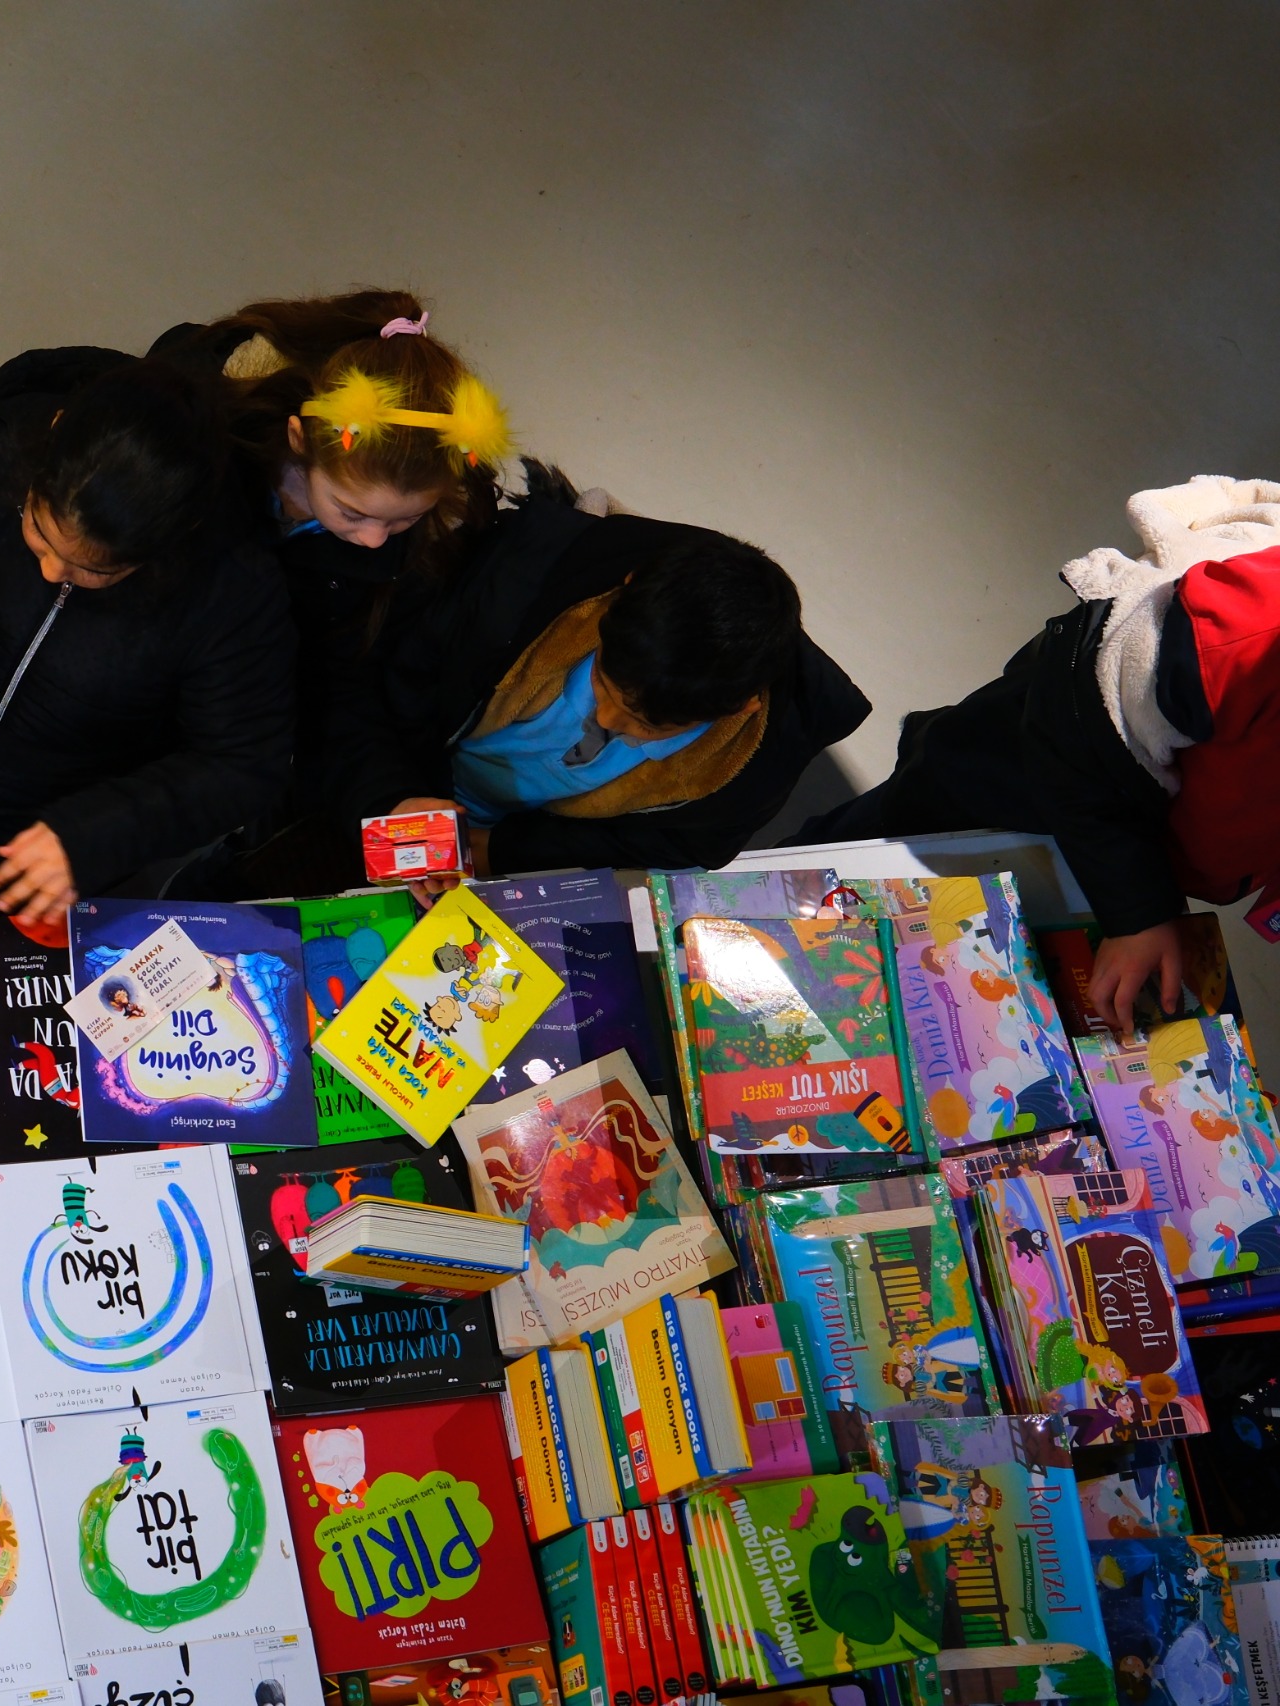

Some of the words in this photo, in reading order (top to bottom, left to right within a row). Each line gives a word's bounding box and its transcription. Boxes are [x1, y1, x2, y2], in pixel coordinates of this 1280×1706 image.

[147, 911, 167, 922] Yaşar
[188, 914, 227, 925] Resimleyen:
[129, 943, 165, 973] SAKARYA
[136, 958, 160, 981] ÇOCUK
[142, 956, 182, 990] EDEBİYATI
[148, 977, 173, 998] FUARI
[170, 1008, 218, 1038] Dili
[390, 997, 455, 1060] ARKADAŞLARI
[138, 1039, 257, 1081] Sevginin
[374, 1007, 455, 1089] NATE
[921, 1012, 955, 1080] Deniz
[356, 1054, 382, 1080] PEIRCE
[829, 1062, 869, 1095] IŞIK
[8, 1067, 43, 1101] DA
[382, 1078, 415, 1110] LINCOLN
[740, 1080, 785, 1102] KEŞFET
[788, 1072, 829, 1102] TUT
[170, 1116, 214, 1130] Zorkirişçi
[215, 1118, 237, 1129] Esat
[775, 1101, 830, 1117] DİNOZORLAR
[60, 1243, 140, 1286] KOKU
[367, 1259, 416, 1272] Benim
[421, 1266, 487, 1281] Dünyam
[369, 1251, 396, 1260] BIG
[400, 1256, 449, 1267] BLOCK
[452, 1263, 507, 1275] BOOKS
[633, 1243, 711, 1290] TİYATRO
[97, 1280, 147, 1320] bir
[560, 1278, 631, 1326] MÜZESİ
[1093, 1271, 1132, 1331] Kedi
[1116, 1245, 1168, 1350] Çizmeli
[306, 1317, 347, 1343] VAR!
[350, 1305, 448, 1339] DUYGULARI
[796, 1265, 868, 1394] Rapunzel
[304, 1346, 332, 1372] DA
[333, 1331, 461, 1371] CANAVARLARIN
[94, 1384, 122, 1395] Özlem
[160, 1375, 189, 1386] Yemen
[179, 1385, 206, 1394] Yazan
[190, 1371, 221, 1383] Gülşah
[541, 1363, 552, 1390] BIG
[650, 1328, 669, 1381] Benim
[663, 1386, 684, 1456] Dünyam
[664, 1310, 676, 1338] BIG
[670, 1342, 689, 1395] BLOCK
[683, 1399, 702, 1455] BOOKS
[33, 1389, 65, 1401] Korçak
[55, 1396, 104, 1410] Resimleyen
[66, 1388, 92, 1398] Fedai
[546, 1395, 564, 1446] BLOCK
[530, 1379, 545, 1430] Benim
[540, 1436, 559, 1504] Dünyam
[557, 1450, 573, 1504] BOOKS
[136, 1489, 199, 1546] tat
[729, 1498, 769, 1584] KİTABINI
[761, 1524, 801, 1588] YEDİ?
[1014, 1484, 1083, 1616] Rapunzel
[147, 1535, 202, 1582] bir
[331, 1497, 482, 1624] PIRT!
[1022, 1543, 1033, 1577] Hareketli
[410, 1621, 436, 1635] Fedai
[437, 1616, 466, 1631] Özlem
[786, 1589, 819, 1636] KİM
[212, 1630, 241, 1641] Yemen
[243, 1625, 276, 1637] Gülşah
[377, 1624, 410, 1640] Korçak
[1247, 1640, 1269, 1700] KEŞFETMEK
